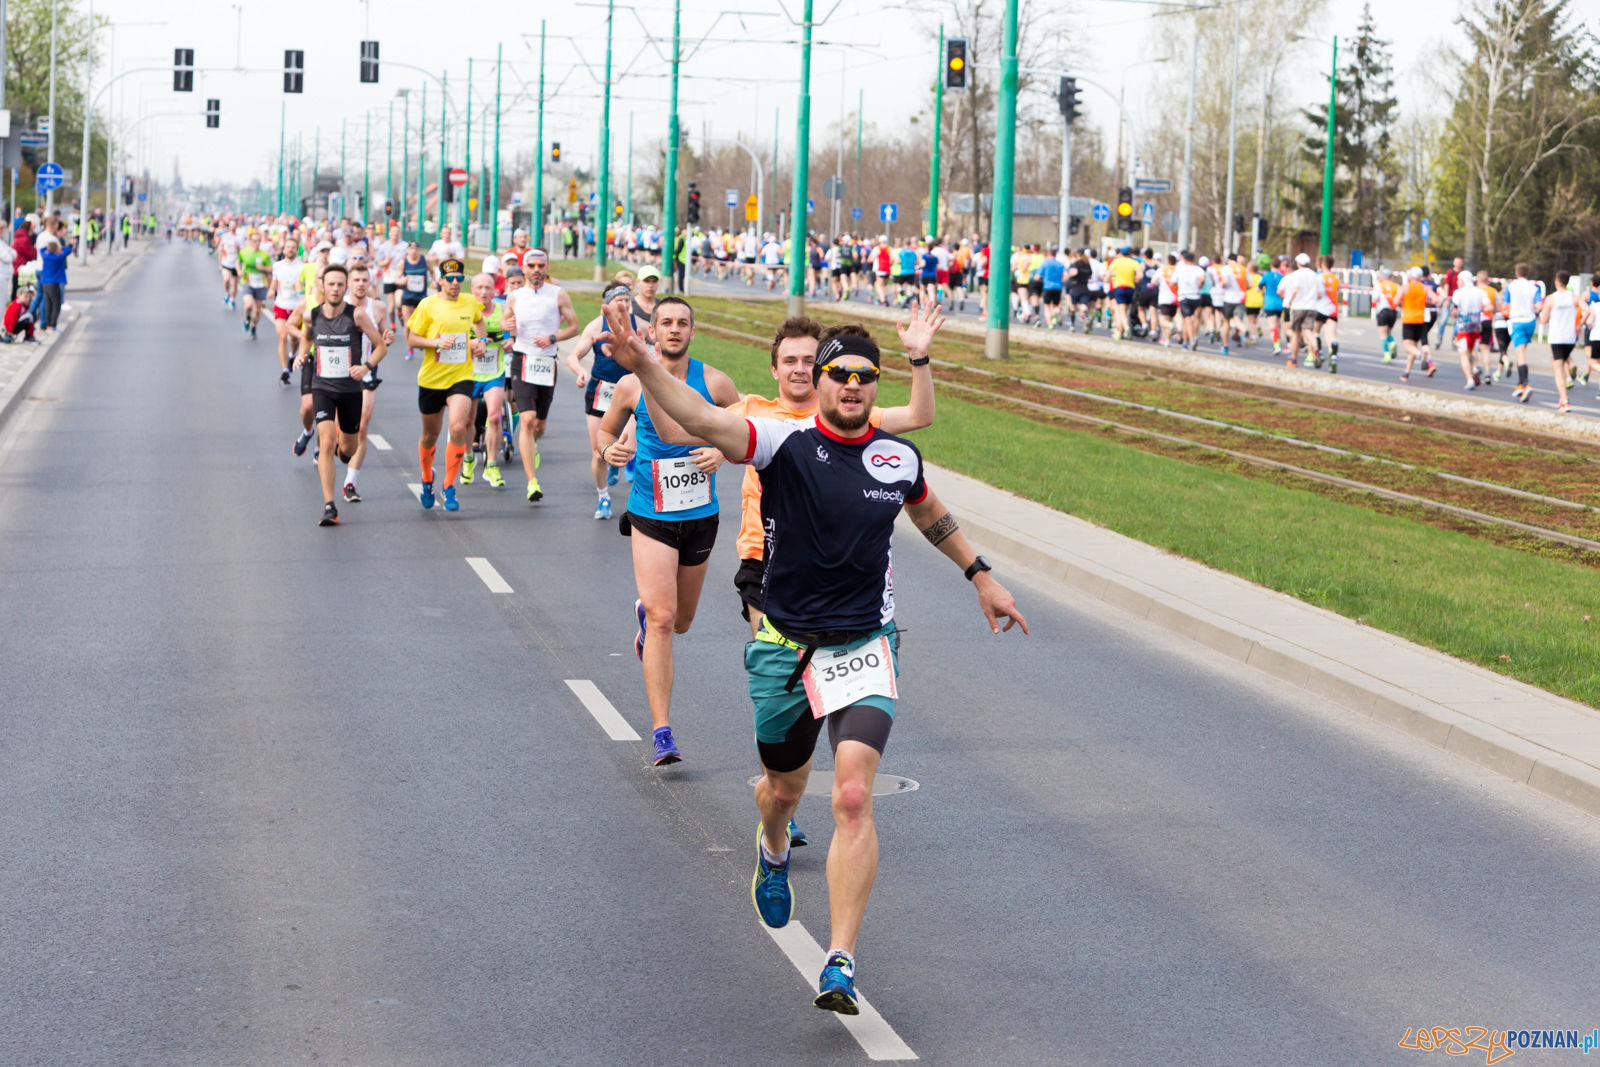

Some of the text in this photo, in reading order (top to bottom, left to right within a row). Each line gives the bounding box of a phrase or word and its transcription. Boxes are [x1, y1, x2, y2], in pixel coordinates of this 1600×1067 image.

[328, 356, 340, 365] 98
[529, 364, 551, 373] 11224
[662, 471, 707, 489] 10983
[863, 488, 905, 505] velocity
[822, 653, 880, 682] 3500
